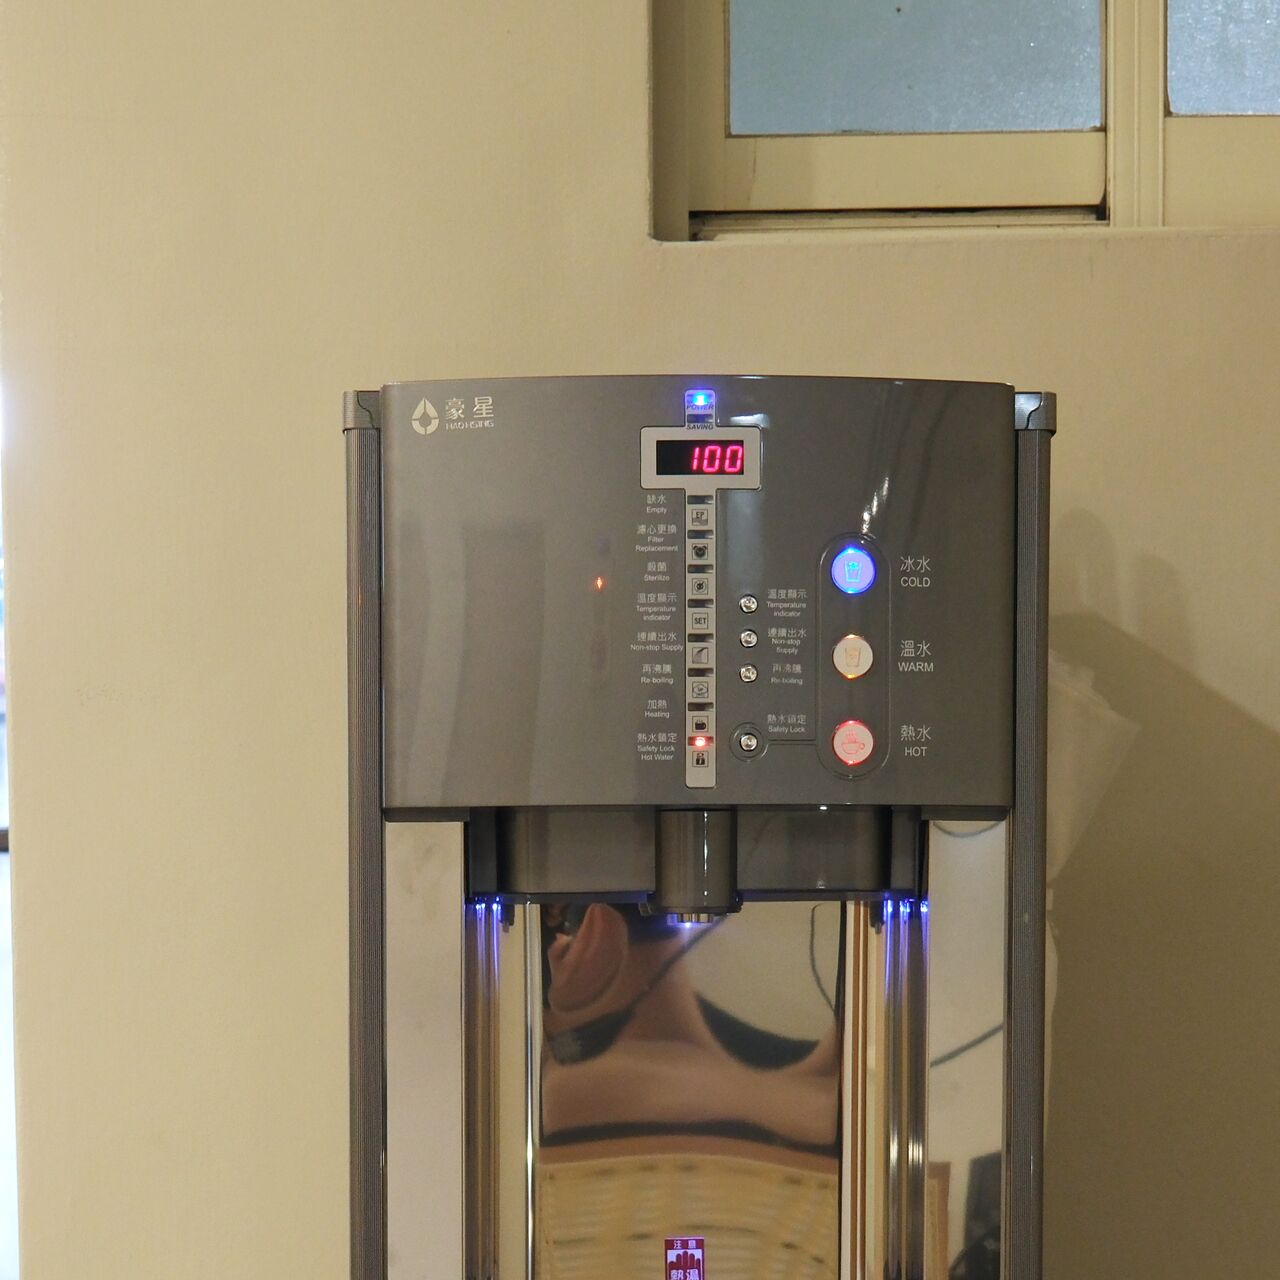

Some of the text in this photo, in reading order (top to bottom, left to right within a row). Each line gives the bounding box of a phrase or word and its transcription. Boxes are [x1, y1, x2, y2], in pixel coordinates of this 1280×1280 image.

[692, 445, 744, 473] 100
[646, 506, 667, 514] Empty
[900, 556, 931, 572] 冰水
[644, 574, 670, 582] Sterilize
[900, 577, 931, 587] COLD
[766, 601, 807, 609] Temperature
[694, 617, 707, 625] SET
[771, 638, 801, 646] Non-stop
[661, 644, 684, 652] Supply
[776, 646, 799, 655] Supply
[900, 639, 932, 657] 溫水
[898, 662, 934, 672] WARM
[768, 725, 806, 734] Safety Lock
[900, 724, 932, 742] 熱水
[637, 744, 675, 752] Safety Lock
[904, 746, 928, 757] HOT
